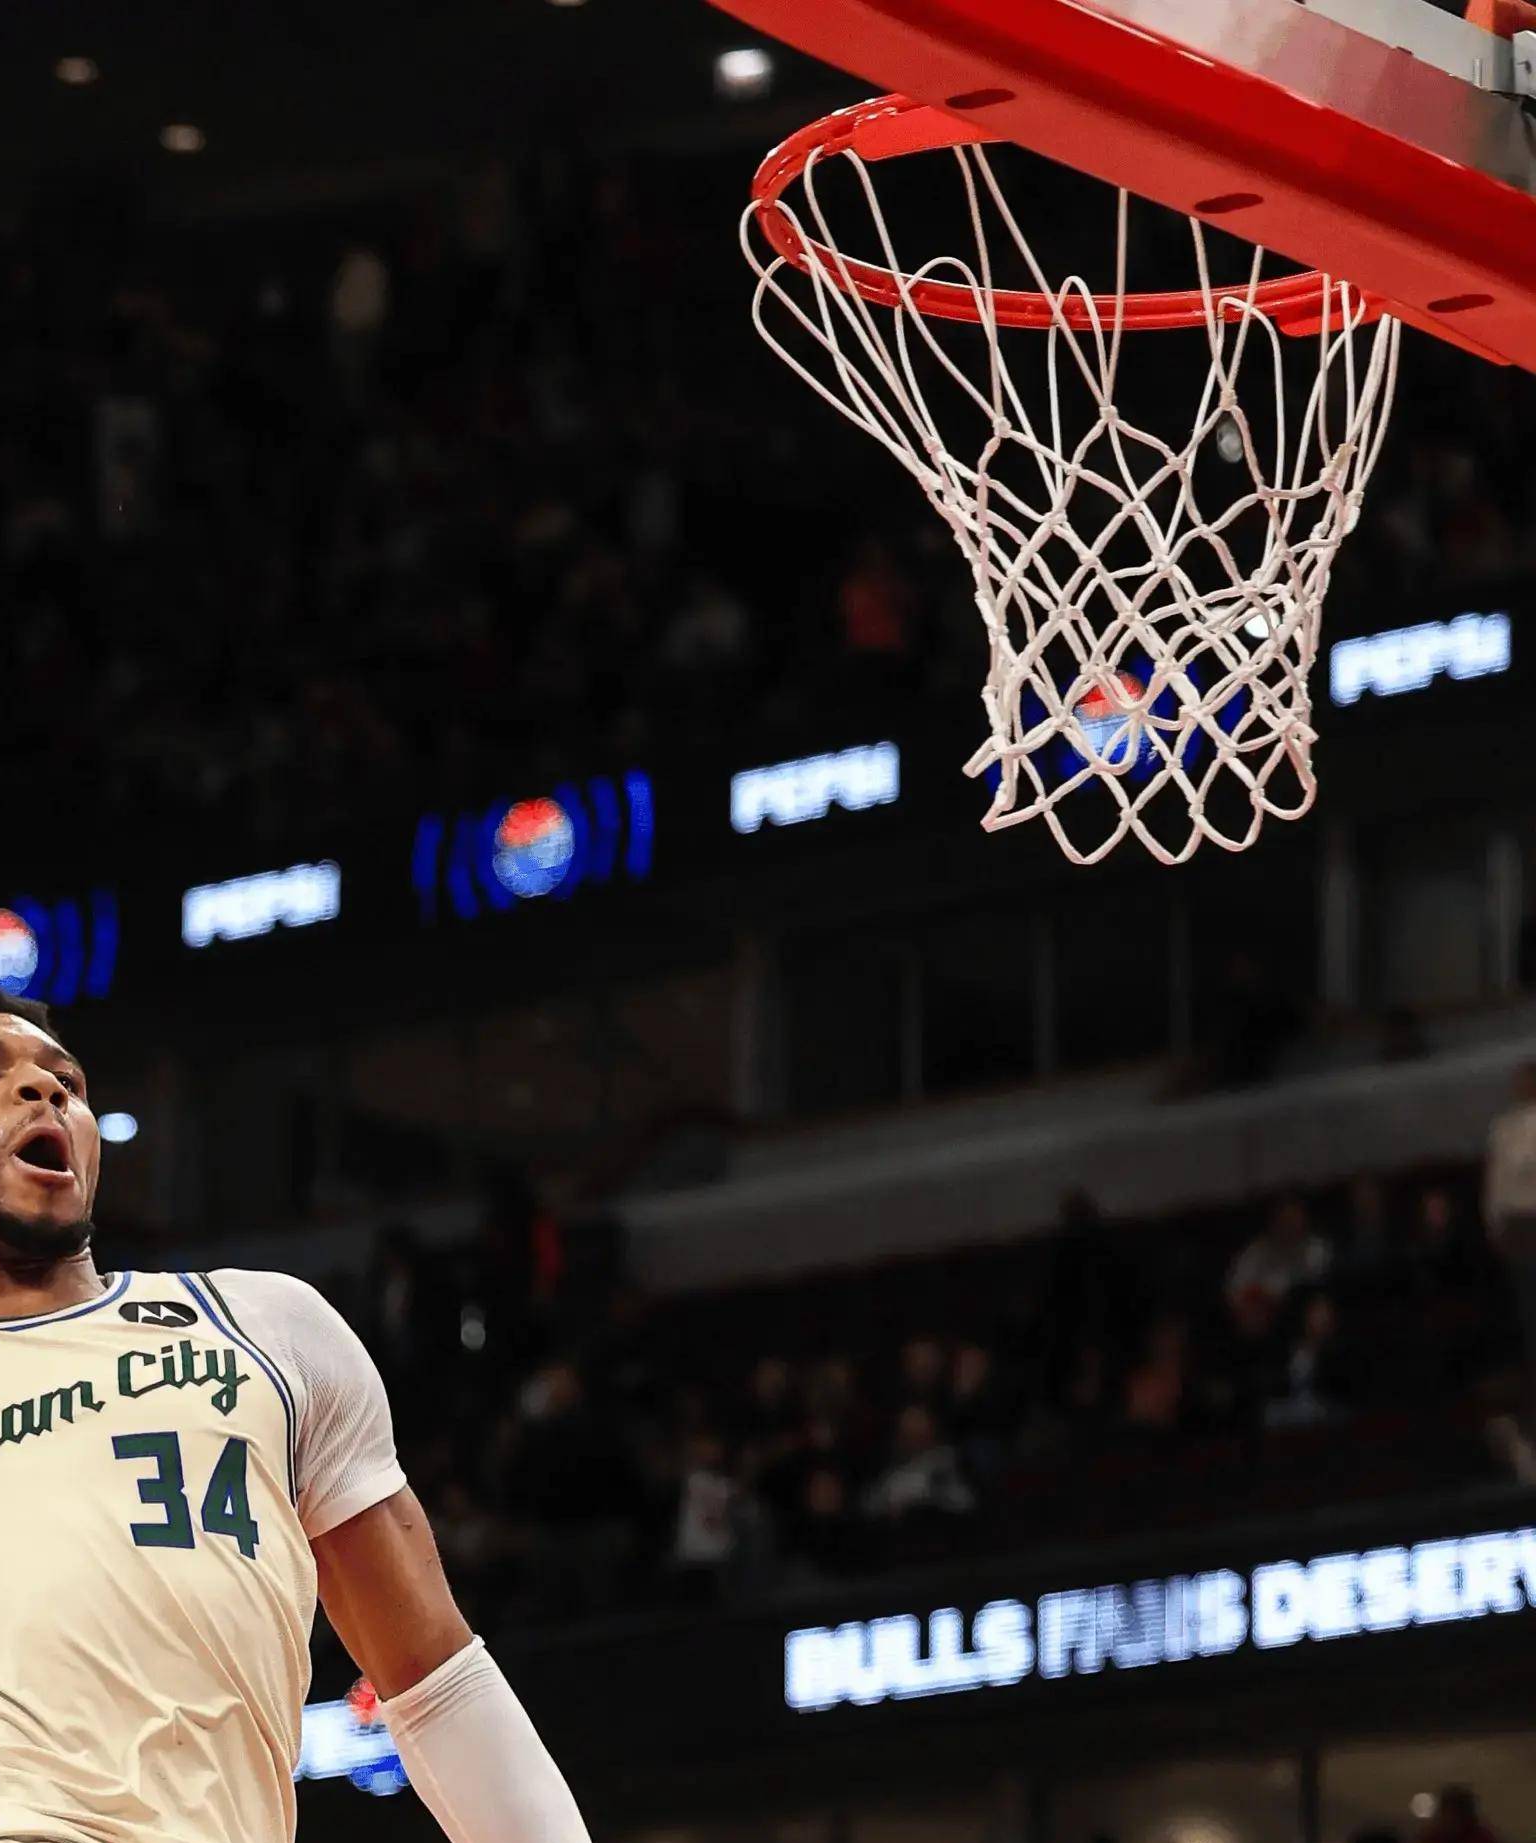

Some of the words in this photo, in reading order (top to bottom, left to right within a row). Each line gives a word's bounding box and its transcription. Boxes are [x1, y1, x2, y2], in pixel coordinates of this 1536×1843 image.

[117, 1340, 250, 1417] City
[111, 1430, 260, 1561] 34
[785, 1599, 1034, 1711] BULLS
